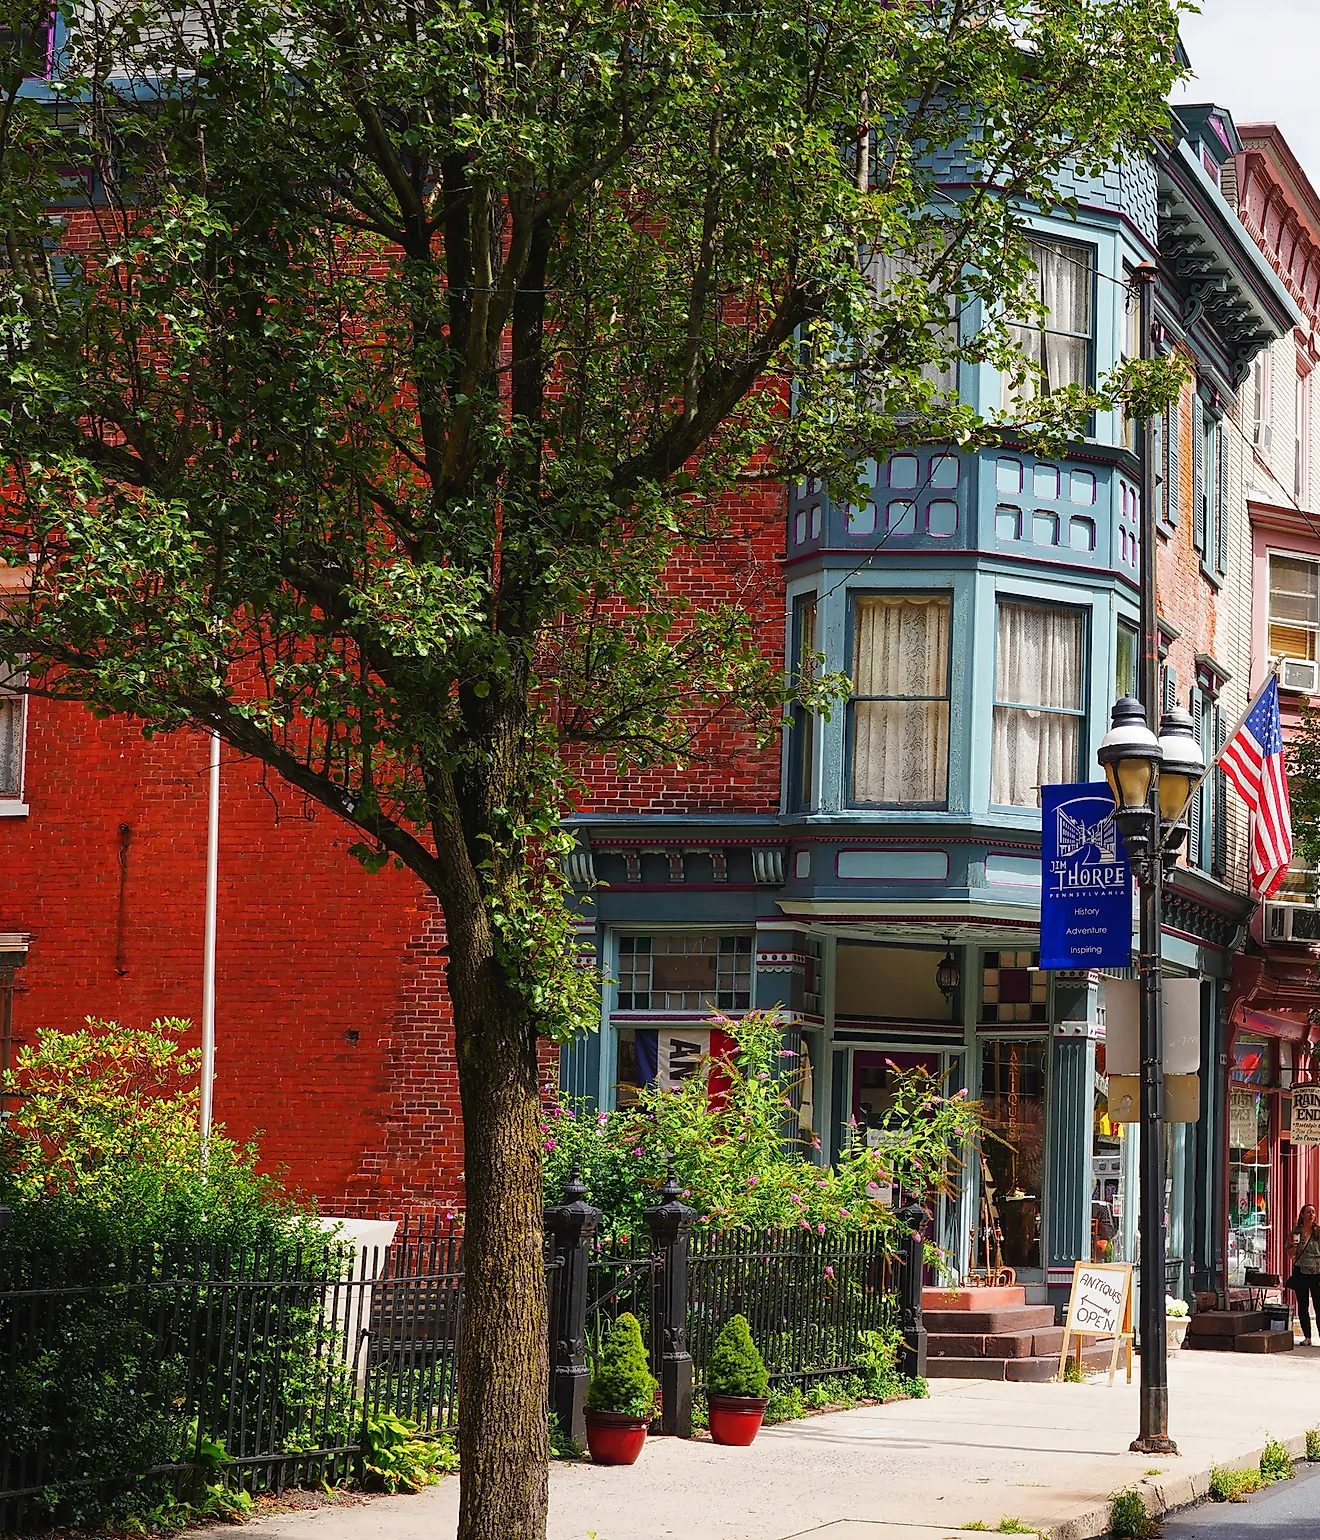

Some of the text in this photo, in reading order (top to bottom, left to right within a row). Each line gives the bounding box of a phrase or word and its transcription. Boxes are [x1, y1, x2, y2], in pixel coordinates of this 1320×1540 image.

[1050, 861, 1067, 872] JIM
[1054, 861, 1125, 891] THORPE
[1074, 908, 1100, 916] History
[1066, 926, 1107, 935] Adventure
[1070, 946, 1102, 954] Inspiring
[1008, 1051, 1018, 1138] ANTIQUES
[1077, 1308, 1115, 1331] OPEN
